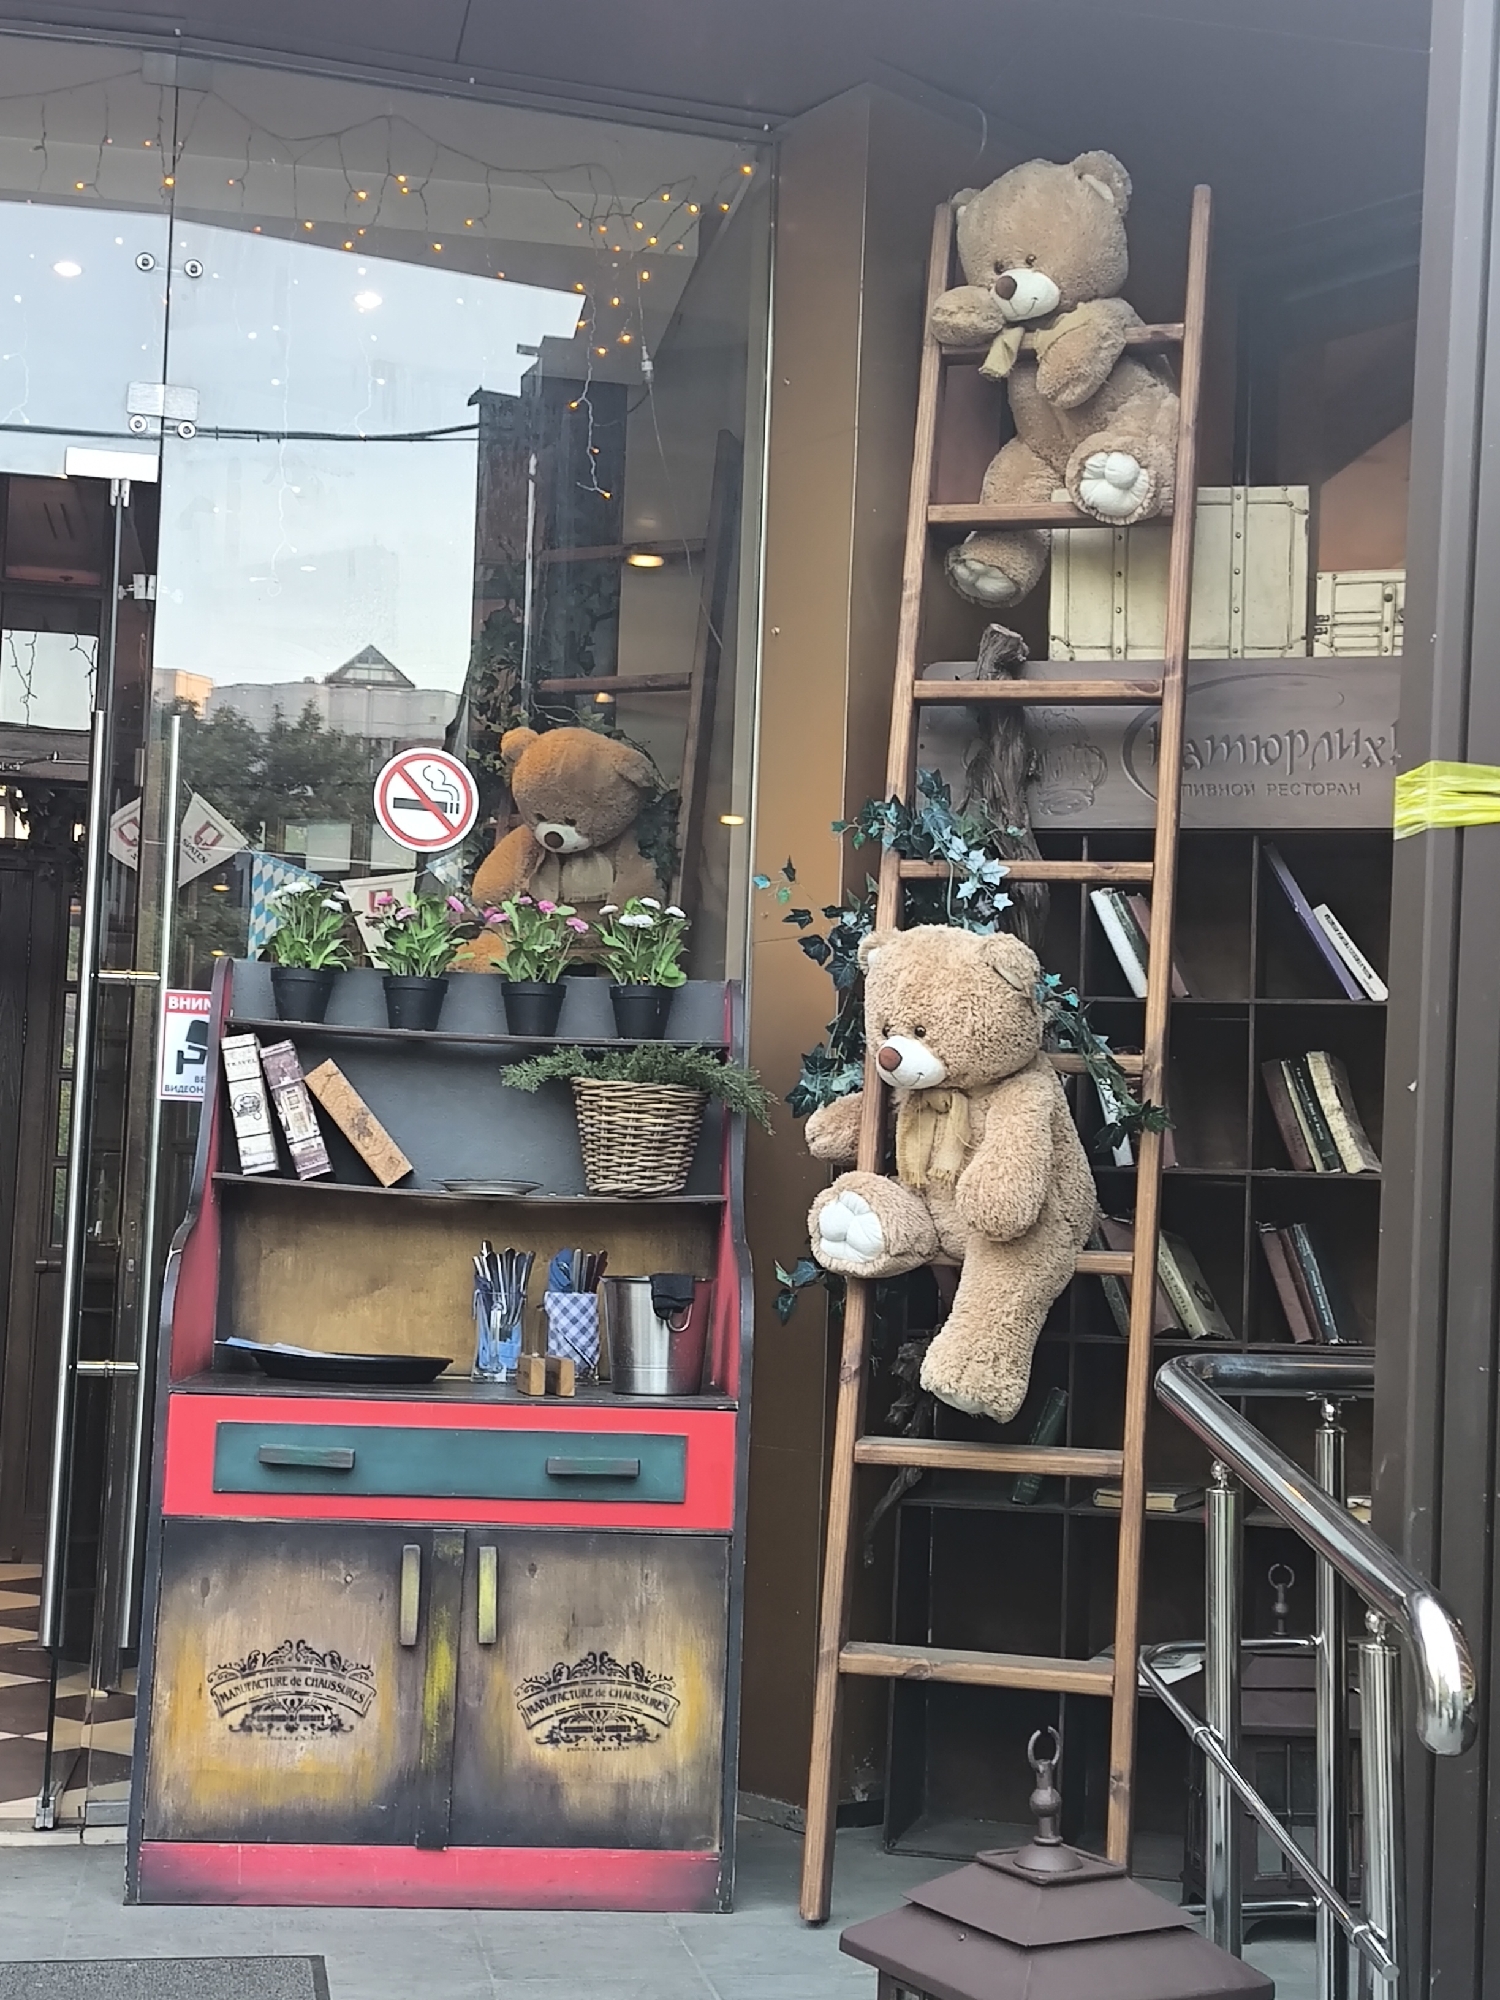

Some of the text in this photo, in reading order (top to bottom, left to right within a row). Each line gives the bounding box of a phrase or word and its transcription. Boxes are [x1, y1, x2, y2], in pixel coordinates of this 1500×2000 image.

[1181, 780, 1361, 797] ПИВНОЙ РЕСТОРАН
[182, 838, 208, 865] SPATEN
[219, 1676, 366, 1704] MANUFACTURE de CHAUSSURES
[526, 1688, 670, 1717] MANUFACTURE de CHAUSSURES
